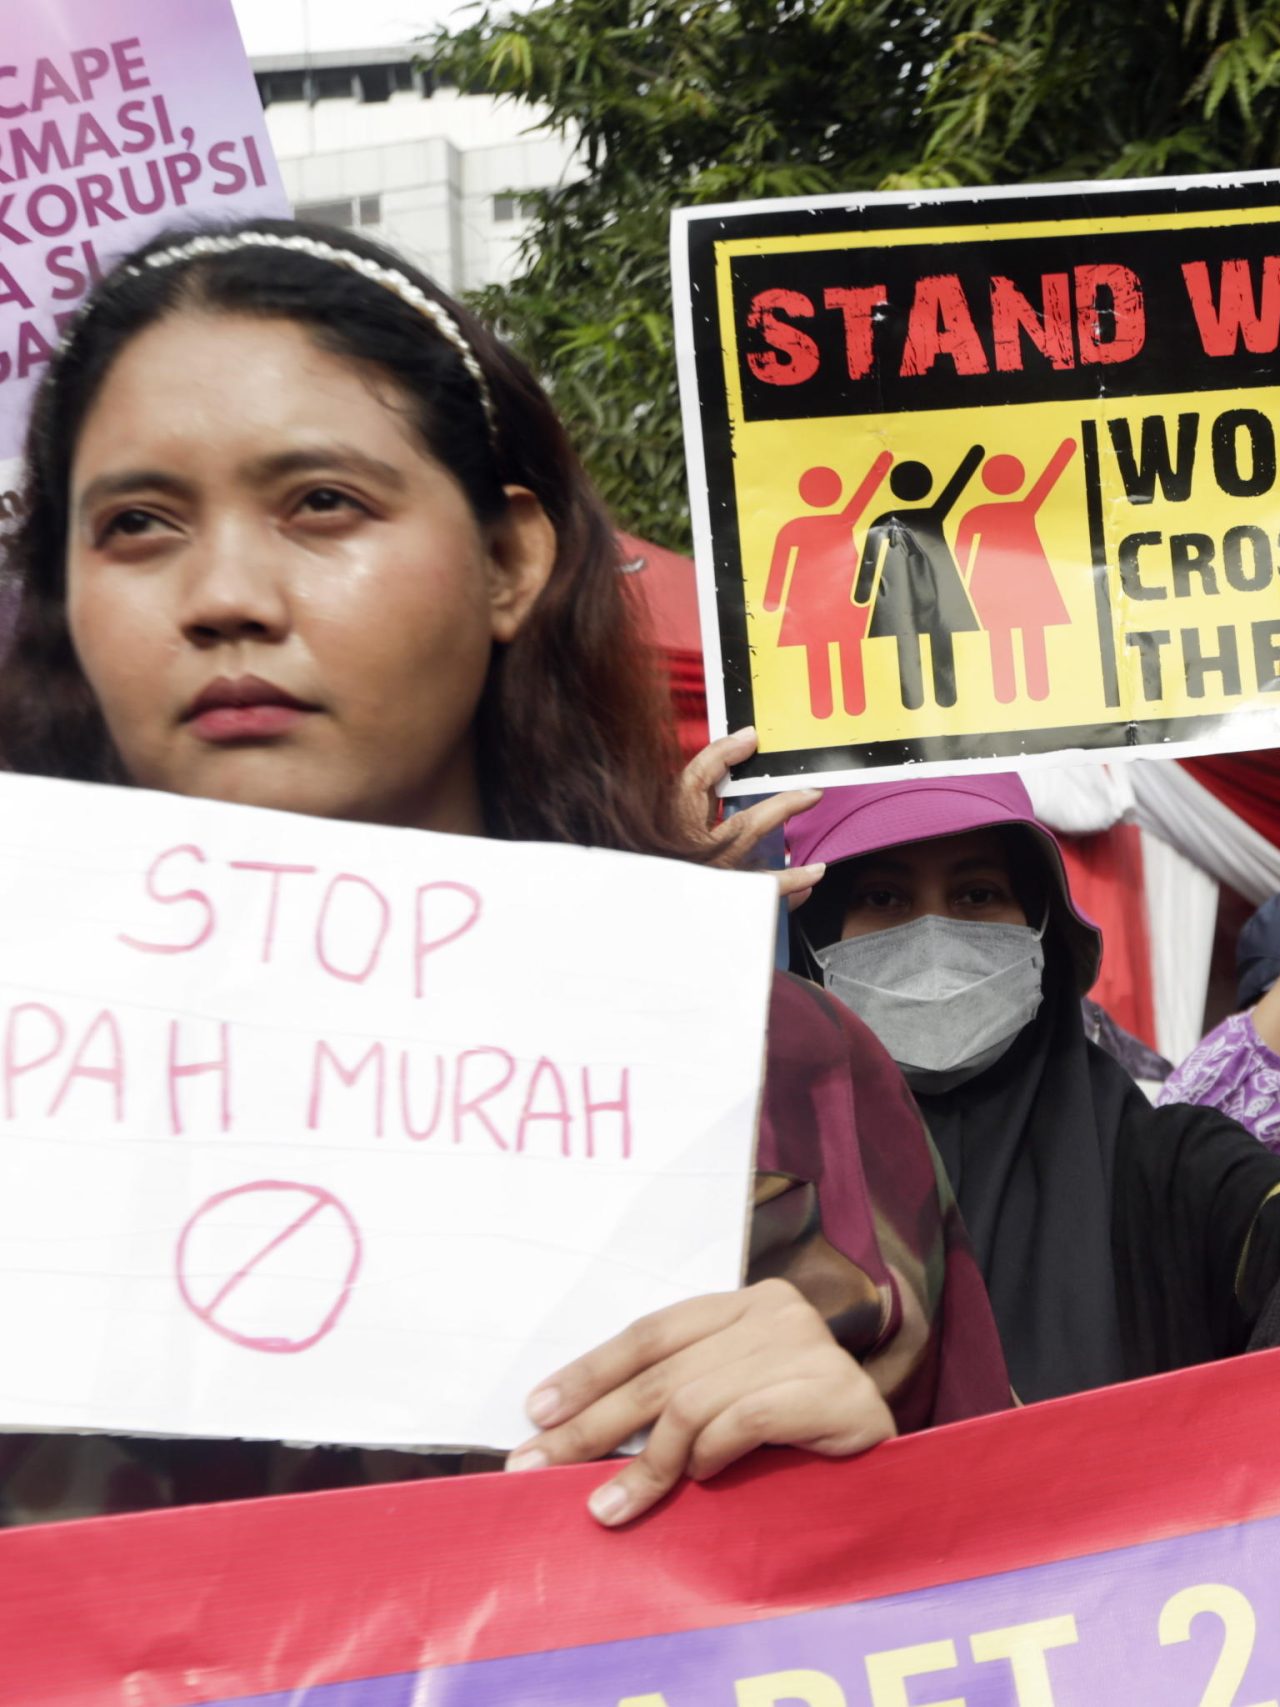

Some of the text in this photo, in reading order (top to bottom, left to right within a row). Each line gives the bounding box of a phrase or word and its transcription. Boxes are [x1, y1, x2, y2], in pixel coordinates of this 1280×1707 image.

[0, 94, 196, 184] MASI,
[745, 263, 1147, 387] STAND
[117, 844, 483, 999] STOP
[2, 1001, 632, 1159] PAH MURAH
